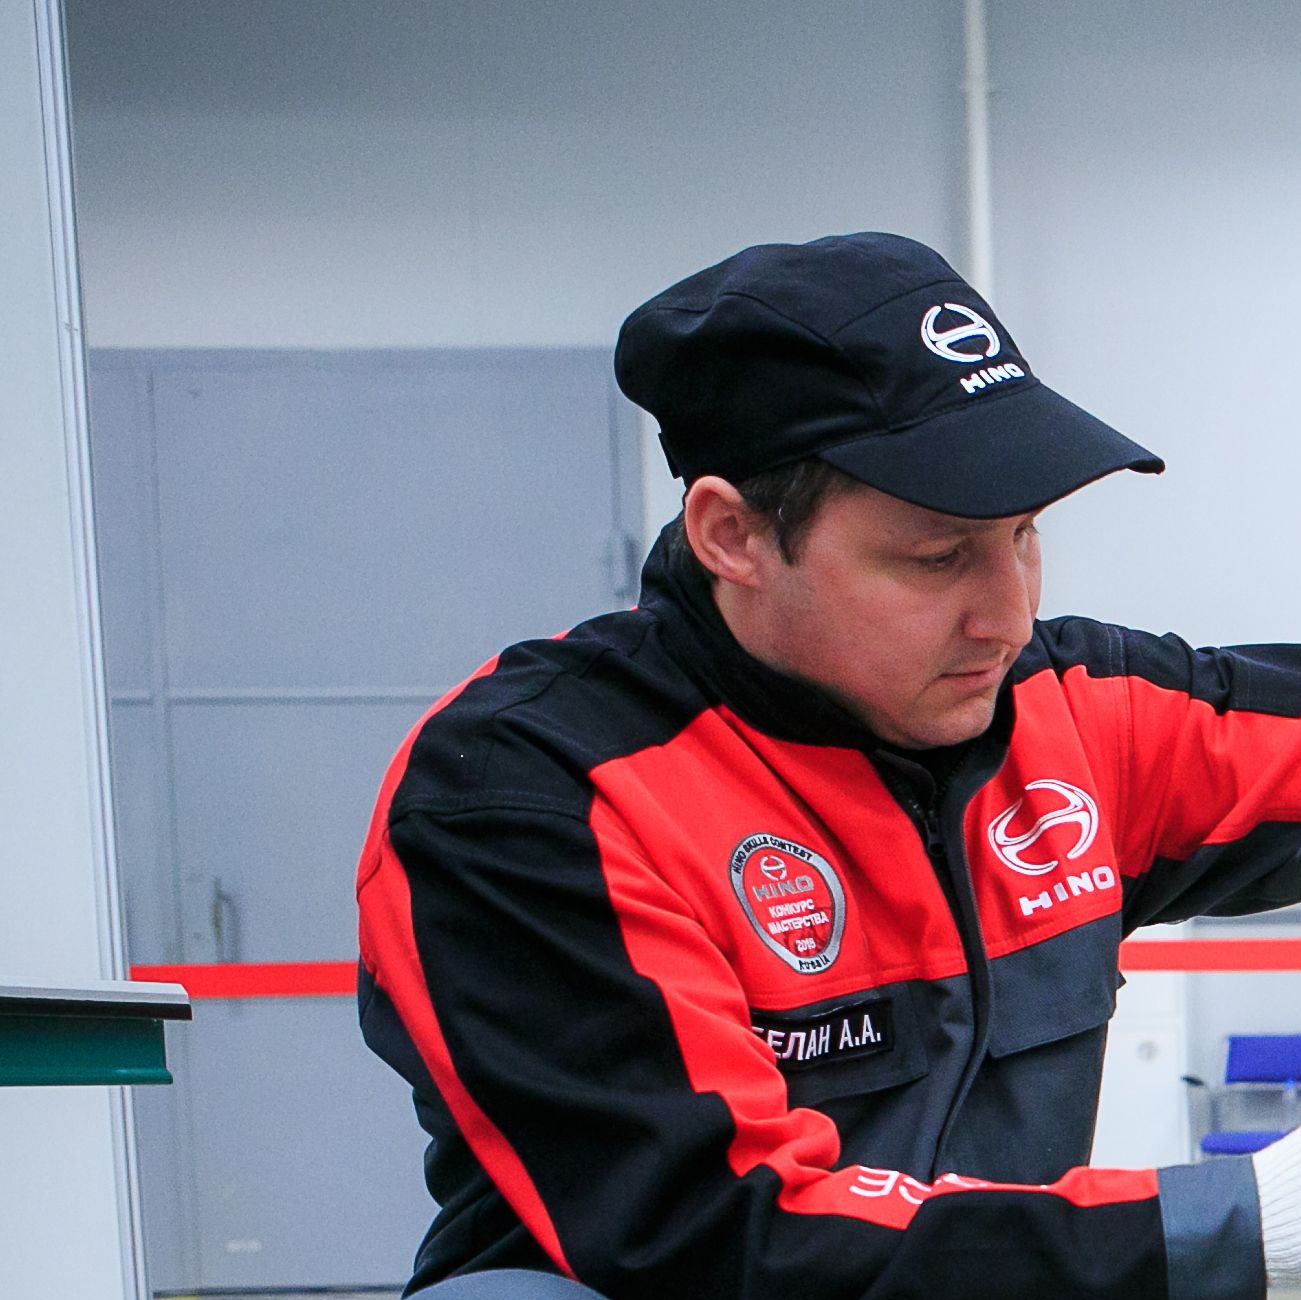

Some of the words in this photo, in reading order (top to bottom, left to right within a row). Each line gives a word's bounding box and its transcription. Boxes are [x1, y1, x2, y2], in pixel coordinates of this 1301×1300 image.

[960, 363, 1025, 394] HINO
[752, 875, 814, 902] HINO
[1019, 866, 1115, 916] HINO
[768, 911, 829, 935] МАСТЕРСТВА
[769, 899, 815, 918] КОНКУРС
[752, 1025, 830, 1060] ЕЛАН
[839, 1015, 882, 1049] А.А.
